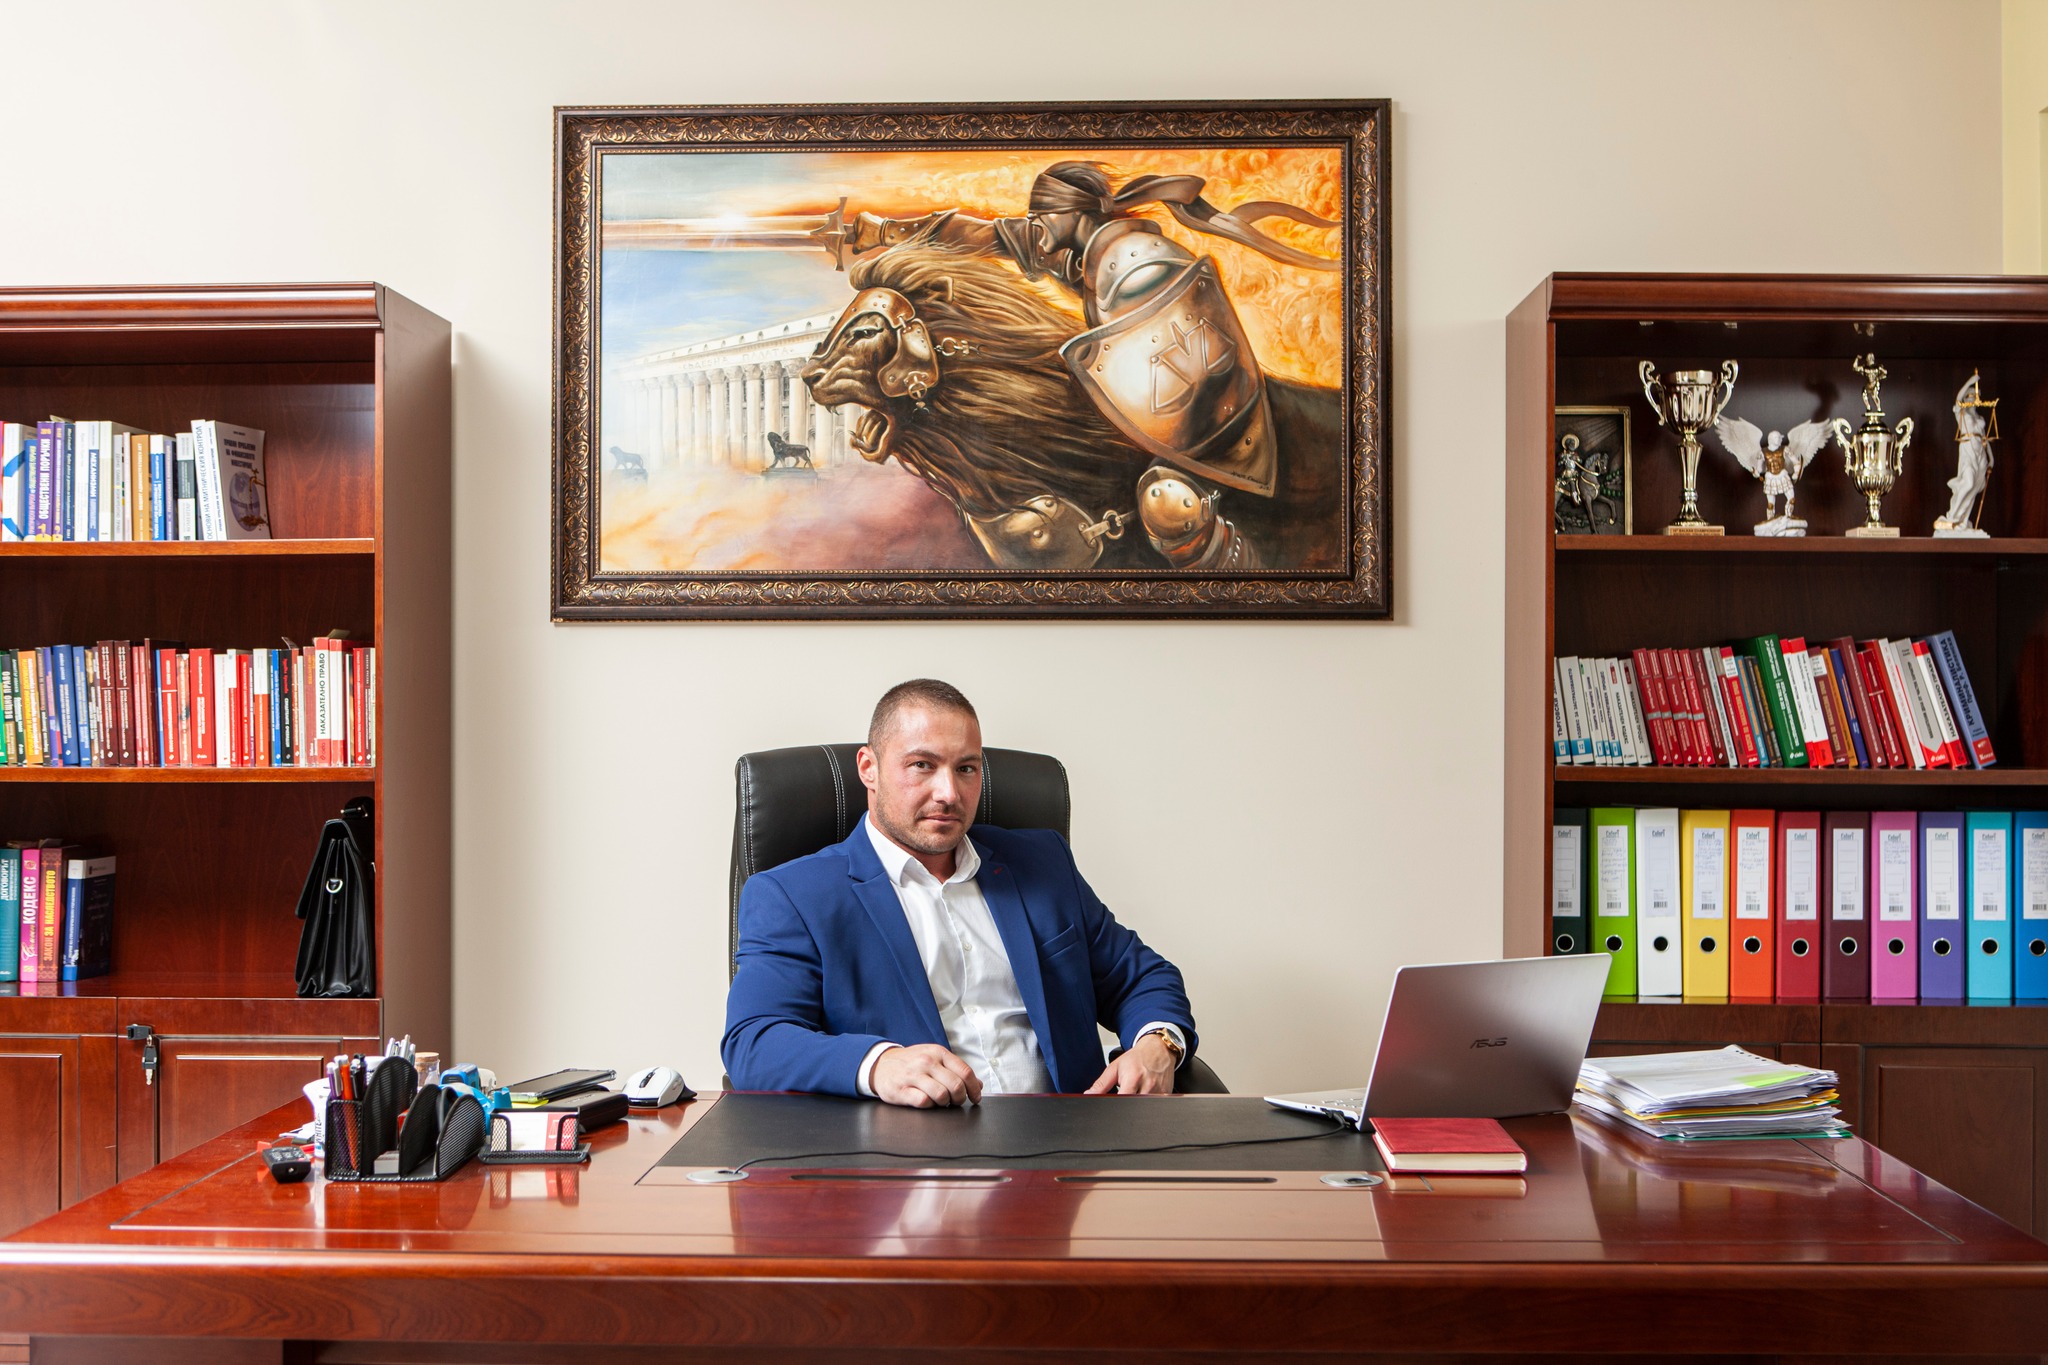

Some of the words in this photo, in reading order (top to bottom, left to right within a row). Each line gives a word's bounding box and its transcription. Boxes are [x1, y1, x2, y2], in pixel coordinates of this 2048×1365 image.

[39, 438, 51, 472] ПОРЪЧКИ
[38, 472, 51, 520] ОБЩЕСТВЕНИ
[318, 652, 326, 679] ПРАВО
[1926, 657, 1939, 683] ПРАВО
[2, 671, 12, 694] ПРАВО
[1940, 639, 1975, 726] КРИМИНАЛИСТИКА
[4, 695, 14, 720] ВЕЩНО
[1936, 683, 1956, 738] НАКАЗАТЕЛНО
[0, 858, 9, 901] ДОГОВОРЪТ
[22, 876, 38, 925] КОДЕКС
[44, 870, 56, 925] НАСЛЕДСТВОТО
[44, 926, 54, 937] ЗА
[43, 937, 54, 962] ЗАКОН
[1470, 1037, 1508, 1049] ASUS
